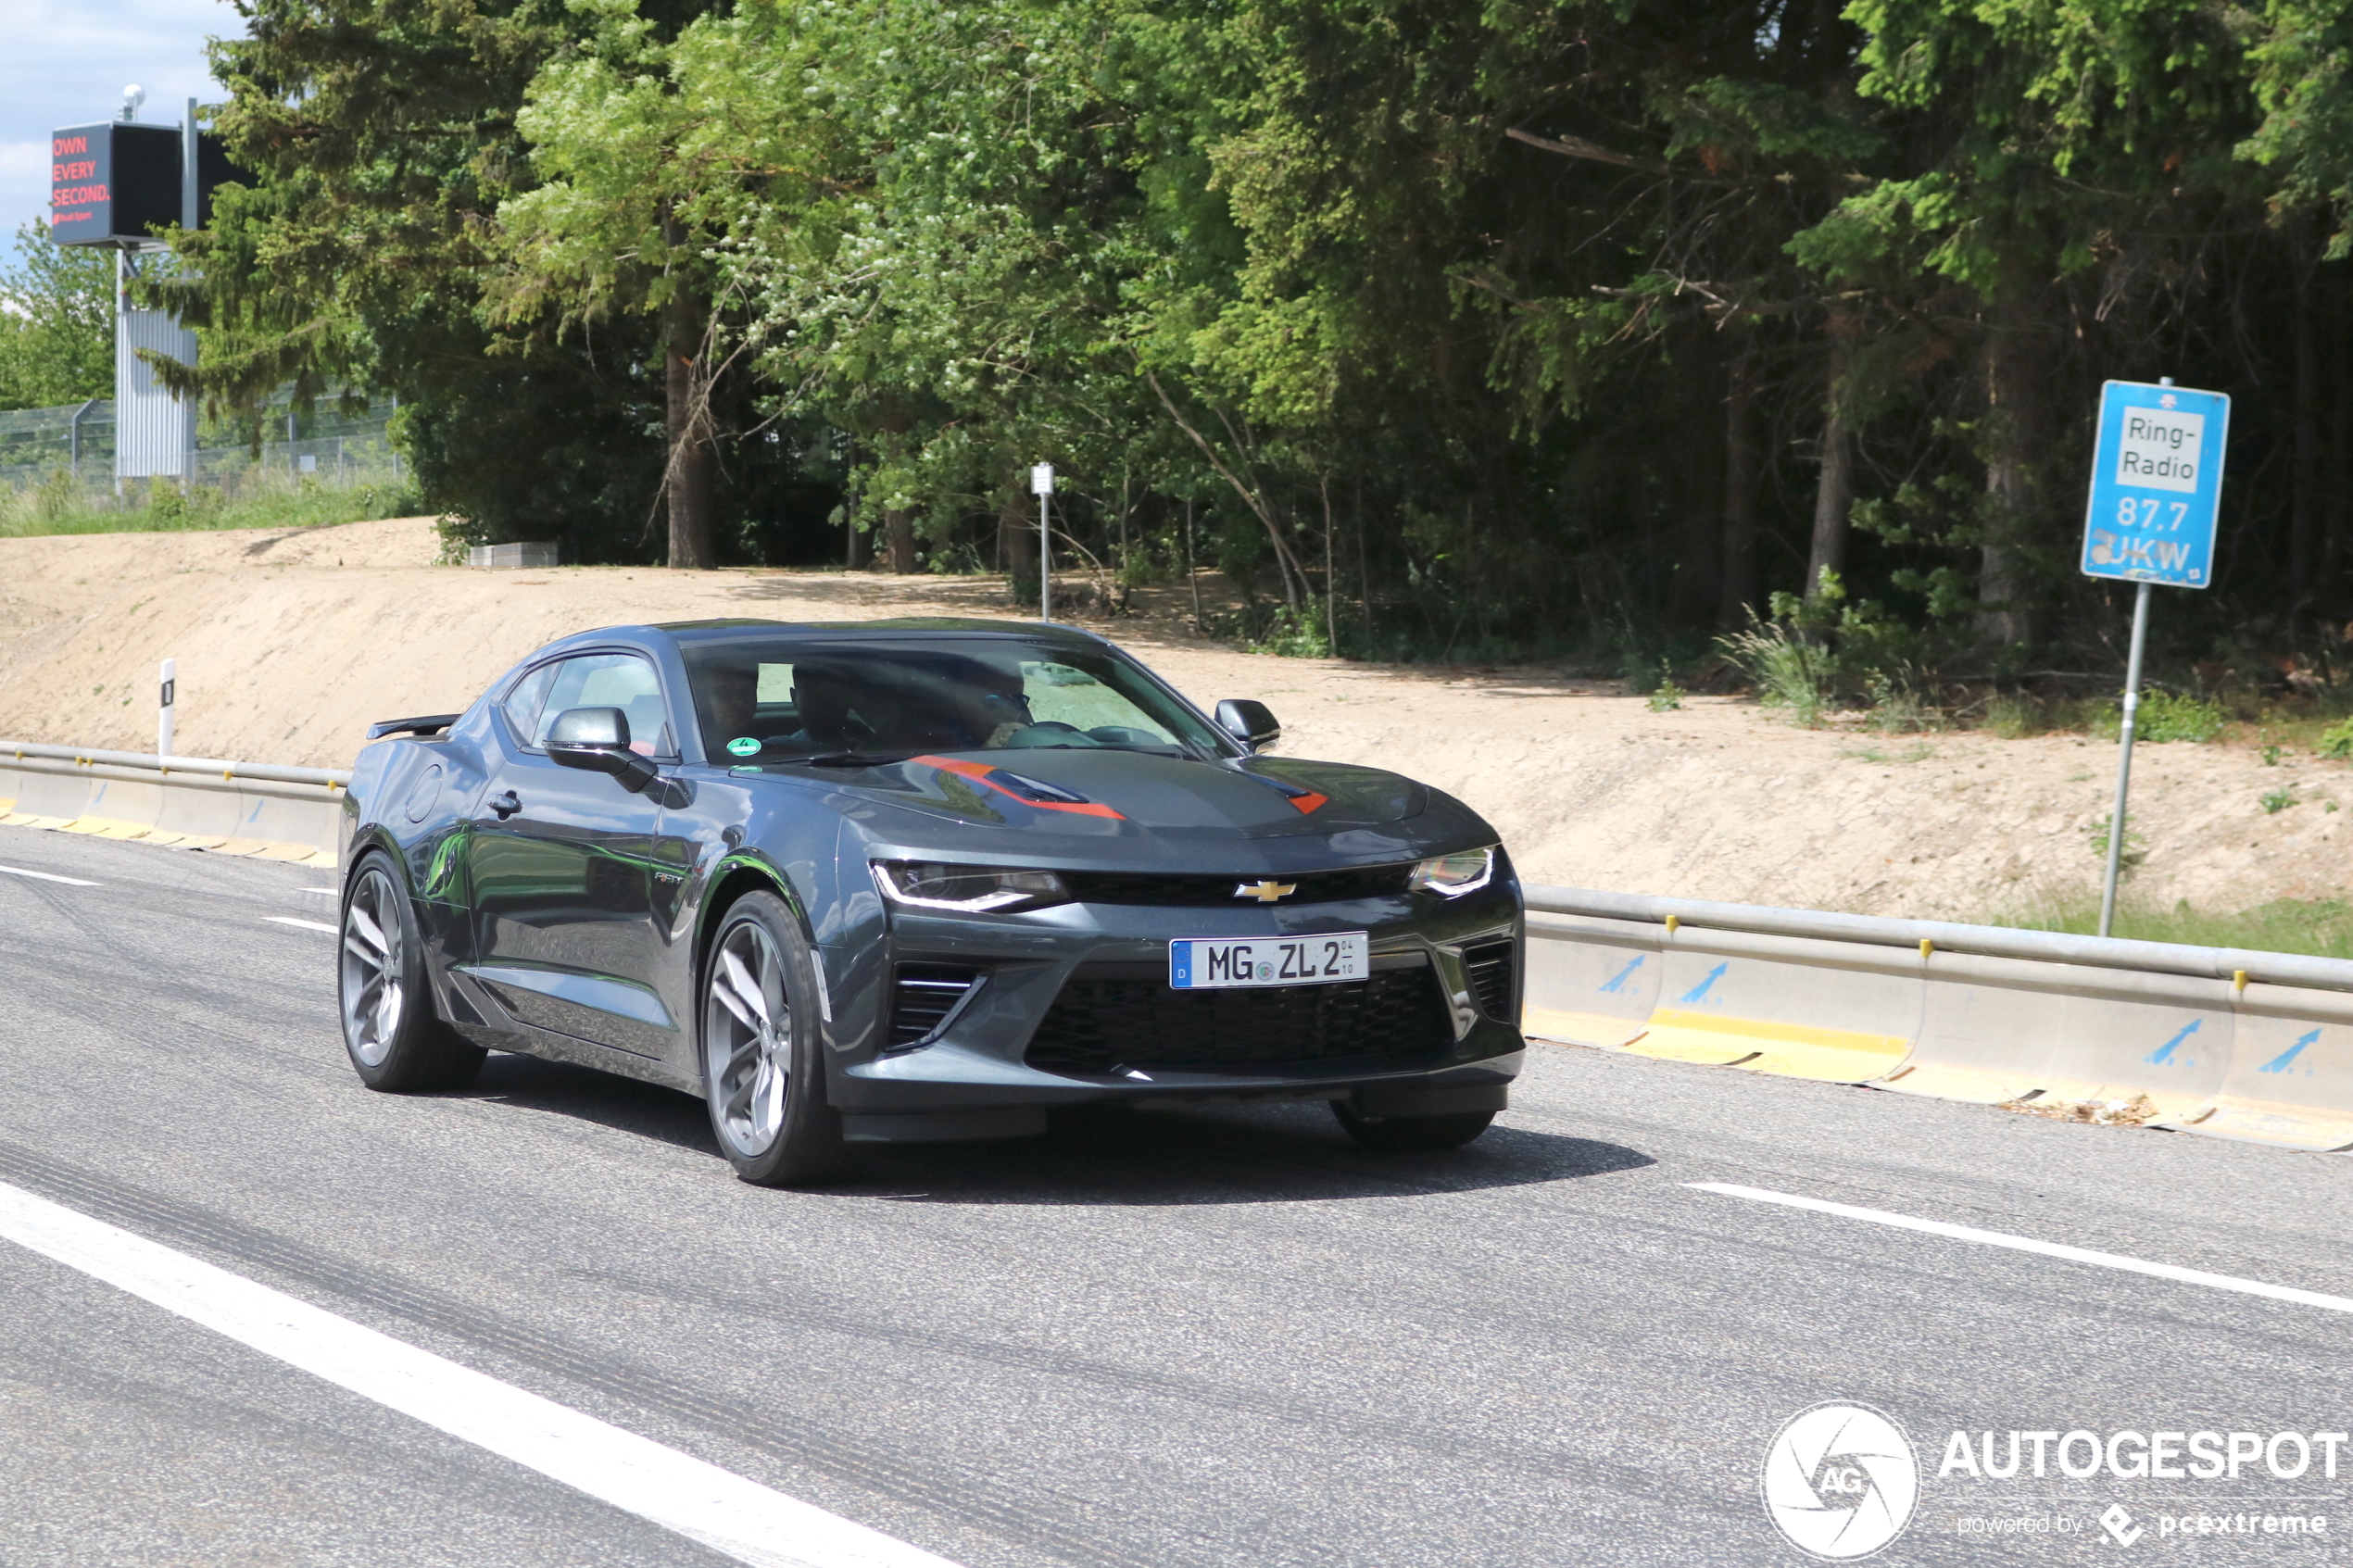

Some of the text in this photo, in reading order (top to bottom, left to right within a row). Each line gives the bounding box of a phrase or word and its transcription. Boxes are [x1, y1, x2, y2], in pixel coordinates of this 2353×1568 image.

[53, 136, 87, 157] OWN
[53, 160, 96, 182] EVERY
[53, 184, 111, 207] SECOND.
[2129, 418, 2196, 449] Ring-
[2122, 451, 2194, 479] Radio
[739, 738, 749, 746] 4
[655, 872, 684, 884] FIFTY
[1208, 941, 1340, 980] MG ZL 2
[1177, 969, 1186, 979] D
